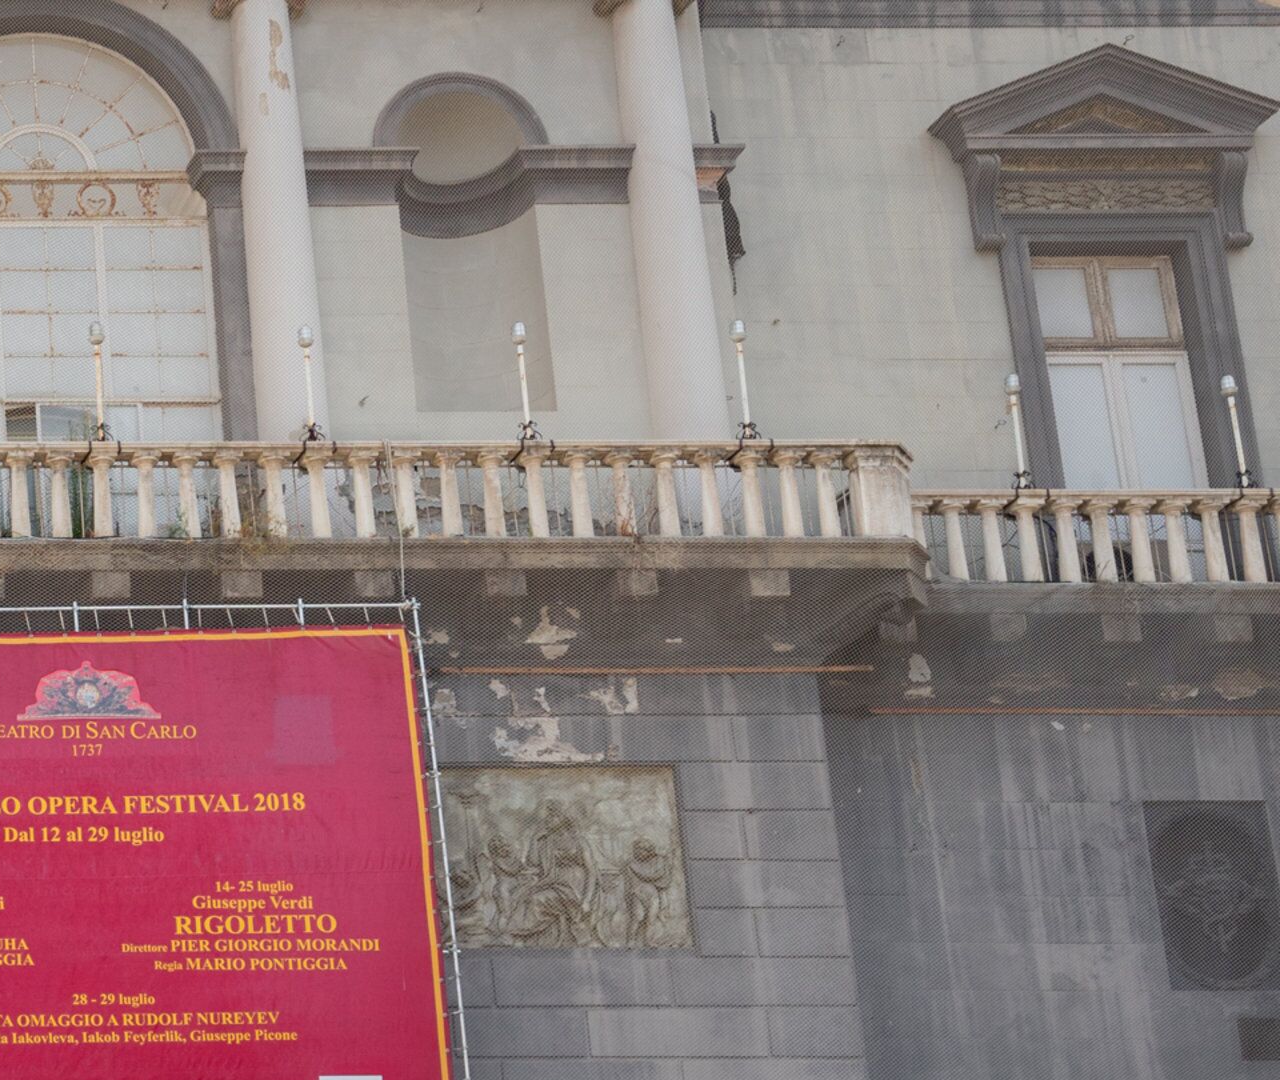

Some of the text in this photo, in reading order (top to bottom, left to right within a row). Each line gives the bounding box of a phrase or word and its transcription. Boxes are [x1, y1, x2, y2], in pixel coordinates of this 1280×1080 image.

[62, 724, 82, 739] DI
[86, 720, 126, 740] SAN
[130, 720, 197, 740] CARLO
[72, 743, 103, 757] 1737
[27, 795, 118, 816] OPERA
[124, 793, 249, 815] FESTIVAL
[254, 792, 306, 812] 2018
[3, 826, 165, 846] Dal 12 al 29 luglio
[239, 880, 254, 893] 25
[257, 880, 294, 894] luglio
[192, 895, 314, 913] Giuseppe Verdi
[174, 914, 338, 936] RIGOLETTO
[122, 938, 380, 953] Direttore PIER GIORGIO MORANDI
[154, 957, 348, 972] Regia MARIO PONTIGGIA
[72, 993, 88, 1005] 28
[100, 993, 116, 1005] 29
[119, 993, 156, 1008] luglio
[16, 1013, 104, 1027] OMAGGIO
[107, 1014, 119, 1026] A
[122, 1012, 193, 1026] RUDOLF
[197, 1011, 280, 1025] NUREYEV
[12, 1032, 79, 1045] Iakovleva,
[82, 1031, 120, 1043] Iakob
[123, 1030, 187, 1045] Feyferlik,
[190, 1030, 251, 1045] Giuseppe
[255, 1029, 298, 1042] Picone
